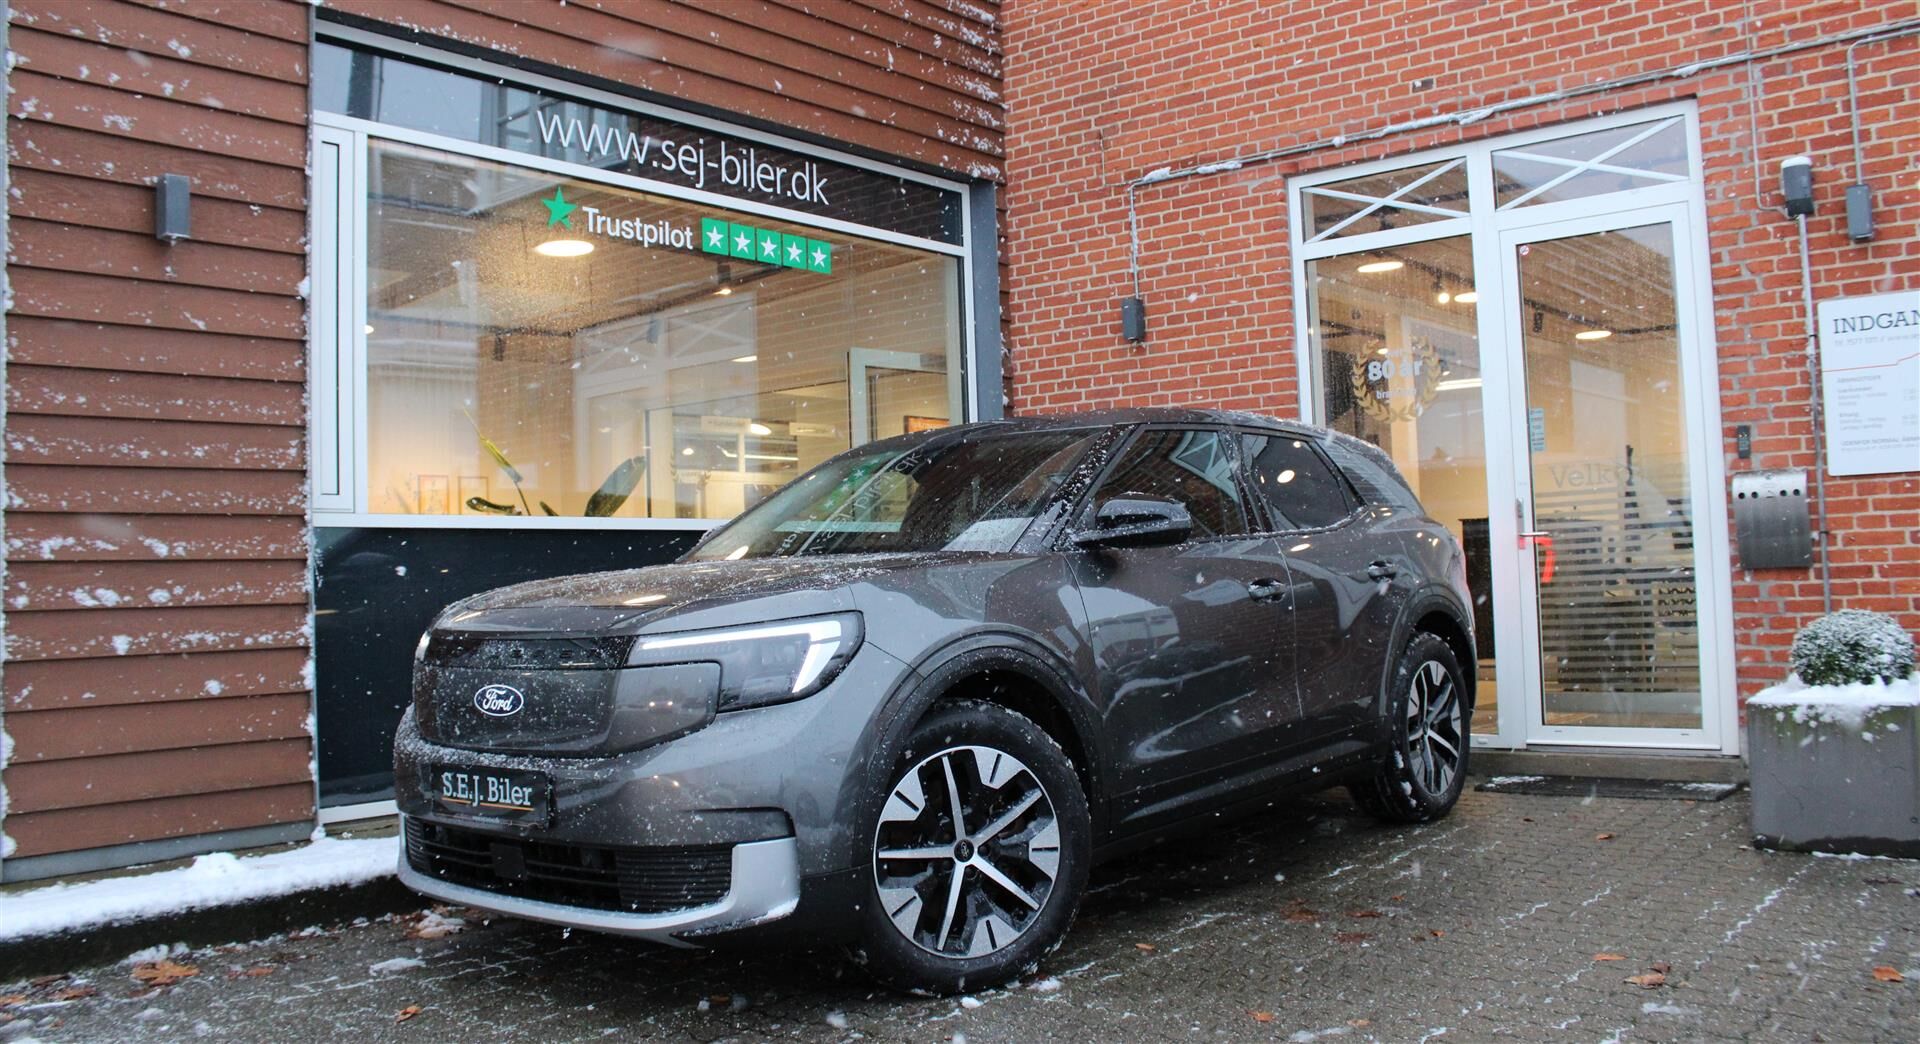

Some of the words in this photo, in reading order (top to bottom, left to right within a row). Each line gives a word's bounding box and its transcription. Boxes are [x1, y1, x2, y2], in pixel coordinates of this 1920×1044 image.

[537, 110, 830, 205] www.sej-biler.dk
[582, 206, 694, 250] Trustpilot
[1368, 360, 1396, 381] 80
[480, 687, 515, 713] Ford
[441, 771, 484, 807] S.E.J.
[487, 776, 533, 806] Biler
